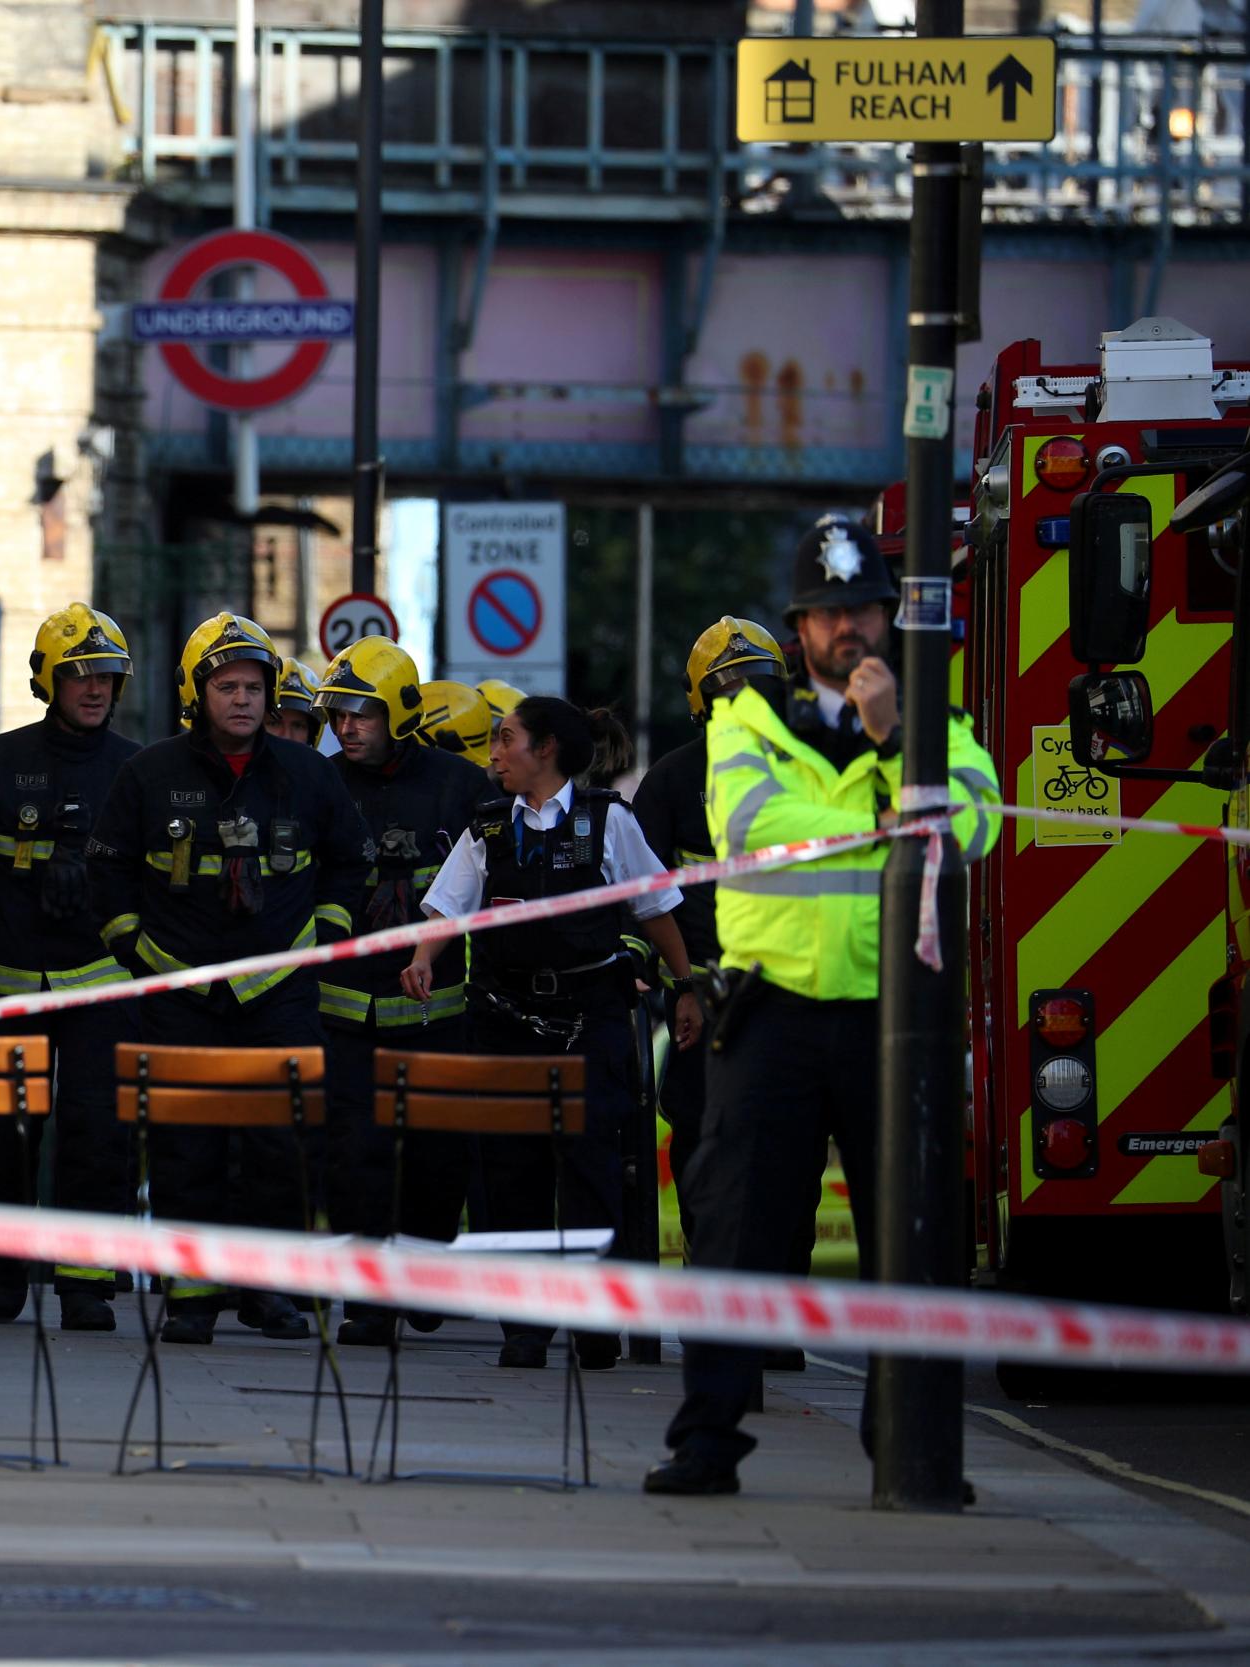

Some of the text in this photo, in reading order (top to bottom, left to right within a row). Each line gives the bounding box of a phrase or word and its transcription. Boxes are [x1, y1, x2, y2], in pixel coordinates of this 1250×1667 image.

[834, 60, 967, 86] FULHAM
[850, 94, 951, 120] REACH
[135, 305, 351, 334] UNDERGROUND
[467, 539, 541, 564] ZONE
[331, 616, 387, 651] 20
[1078, 806, 1110, 817] back
[1128, 1138, 1220, 1153] Emergen
